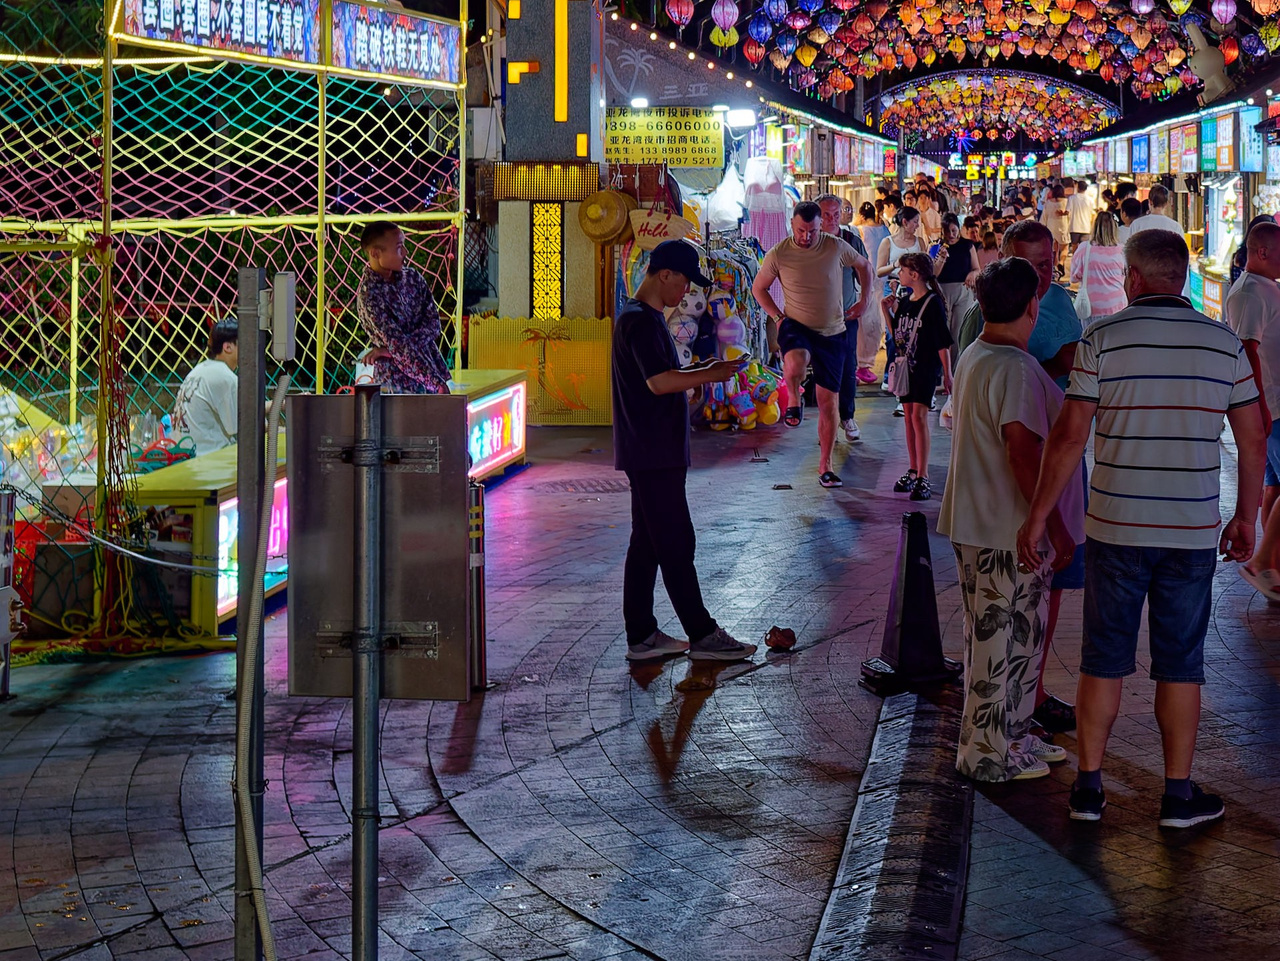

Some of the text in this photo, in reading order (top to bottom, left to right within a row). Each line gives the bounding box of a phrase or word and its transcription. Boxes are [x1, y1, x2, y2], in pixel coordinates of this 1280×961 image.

[355, 18, 440, 74] 踏破铁鞋无觅处
[610, 135, 711, 145] 亚龙湾夜市招商电话
[692, 157, 717, 165] 5217
[638, 222, 669, 237] Hello
